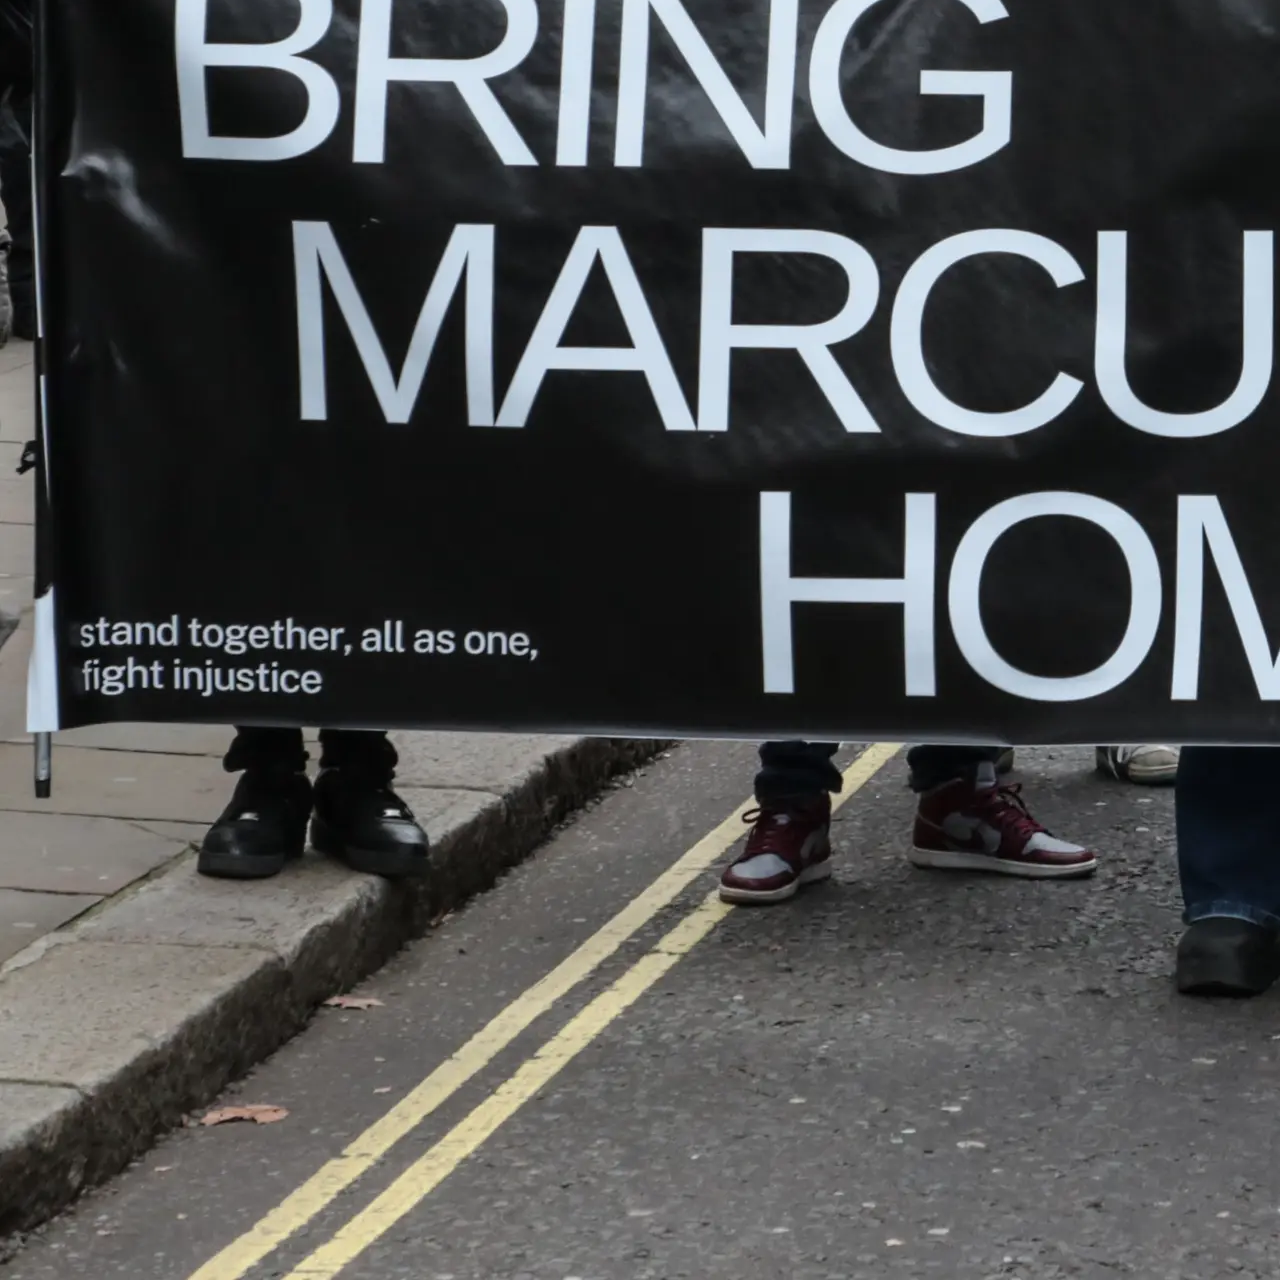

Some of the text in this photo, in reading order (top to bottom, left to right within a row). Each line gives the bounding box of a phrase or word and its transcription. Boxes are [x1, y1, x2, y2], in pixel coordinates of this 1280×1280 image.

[80, 615, 539, 662] stand together, all as one,
[81, 656, 322, 698] fight injustice
